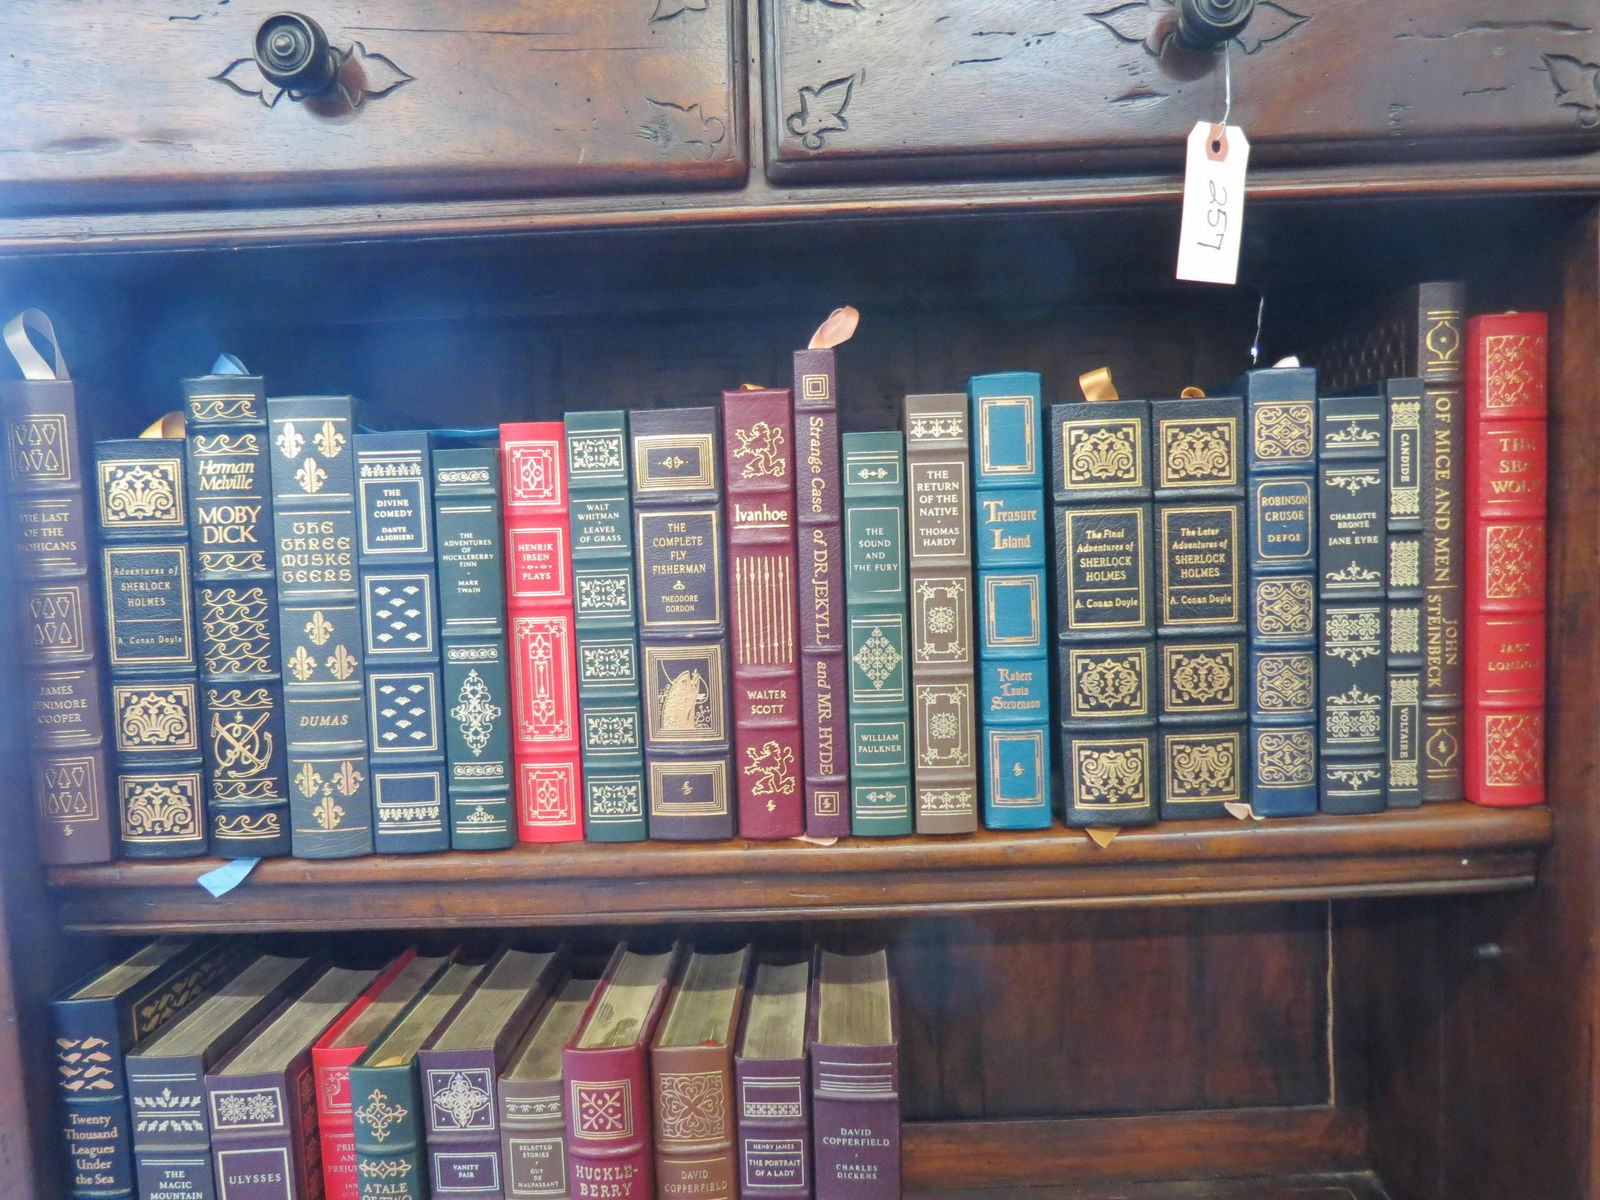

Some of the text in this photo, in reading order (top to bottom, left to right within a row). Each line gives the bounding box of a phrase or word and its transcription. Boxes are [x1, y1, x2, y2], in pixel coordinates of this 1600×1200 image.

[1197, 180, 1228, 250] 257
[808, 416, 824, 474] Strange
[1401, 433, 1410, 483] CANDIDE
[198, 460, 255, 475] Herman
[926, 470, 949, 479] THE
[199, 475, 253, 491] Melville
[916, 481, 960, 492] RETURN
[383, 489, 401, 497] THE
[811, 477, 826, 513] Case
[1434, 397, 1451, 582] OF MICE AND MEN
[376, 499, 409, 508] DIVINE
[919, 494, 958, 504] OF THE
[1261, 495, 1308, 506] ROBINSON
[586, 503, 610, 512] WALT
[734, 503, 788, 522] Ivanhoe
[919, 506, 959, 517] NATIVE
[983, 499, 1037, 524] Treasure
[41, 512, 69, 522] LAST
[198, 505, 262, 525] MOBY
[374, 509, 413, 518] COMEDY
[577, 511, 620, 521] WHITMAN
[1264, 511, 1304, 521] CRUSOE
[1330, 512, 1376, 521] CHARLOTTE
[24, 527, 65, 537] OF THE
[382, 526, 407, 534] DANTE
[584, 525, 616, 534] LEAVES
[667, 523, 687, 533] THE
[865, 527, 884, 536] THE
[919, 527, 959, 536] THOMAS
[1180, 527, 1220, 537] The Later
[203, 525, 258, 544] DICK
[376, 534, 414, 542] ALIGHIERI
[580, 534, 622, 544] OF GRASS
[813, 529, 828, 547] of
[989, 528, 1031, 551] Island
[1086, 529, 1125, 539] The Final
[1267, 533, 1301, 543] DEFOE
[652, 536, 704, 548] COMPLETE
[858, 539, 891, 548] SOUND
[923, 537, 957, 548] HARDY
[1172, 539, 1228, 550] Adventures of
[1328, 535, 1379, 546] JANE EYRE
[517, 543, 554, 552] HENRIK
[1076, 542, 1135, 553] Adventures of
[281, 552, 351, 567] MUSKE
[442, 553, 494, 561] HUCKLEBERRY
[523, 553, 550, 561] IBSEN
[670, 551, 687, 560] FLY
[865, 551, 886, 560] AND
[1174, 553, 1226, 565] SHERLOCK
[854, 563, 899, 572] THE FURY
[1079, 556, 1132, 568] SHERLOCK
[113, 565, 178, 576] Adventures of
[652, 563, 706, 575] FISHERMAN
[1180, 567, 1220, 579] HOLMES
[522, 572, 552, 580] PLAYS
[1086, 570, 1126, 582] HOLMES
[121, 581, 170, 590] SHERLOCK
[128, 597, 166, 607] HOLMES
[661, 595, 699, 603] THEODORE
[1075, 597, 1138, 609] A. Conan Doyle
[1170, 594, 1231, 605] A. Conan Doyle
[665, 604, 695, 613] GORDON
[811, 577, 830, 646] JEKYLL
[130, 636, 154, 644] Conan
[158, 635, 182, 645] Doyle
[1427, 594, 1442, 688] STEINBECK
[1442, 617, 1457, 665] JOHN
[817, 661, 831, 689] and
[997, 667, 1033, 682] Robert
[40, 685, 74, 695] JAMES
[746, 689, 788, 700] WALTER
[751, 703, 785, 714] SCOTT
[38, 713, 82, 723] COOPER
[299, 714, 349, 728] DUMAS
[861, 734, 899, 743] WILLIAM
[1400, 707, 1409, 759] VOLTAIRE
[819, 726, 834, 776] HYDE
[858, 744, 902, 753] FAULKNER
[69, 1114, 112, 1127] Twenty
[64, 1127, 119, 1140] Thousand
[840, 1128, 872, 1136] DAVID
[822, 1136, 891, 1147] COPPERFIELD
[71, 1143, 115, 1158] Leagues
[76, 1158, 112, 1169] Under
[764, 1159, 801, 1167] PORTRAIT
[836, 1163, 878, 1172] CHARLES
[164, 1170, 185, 1179] THE
[458, 1171, 475, 1179] FAIR
[575, 1165, 640, 1180] HUCKLE-
[681, 1169, 709, 1181] DAVID
[755, 1169, 795, 1177] OF A LADY
[837, 1172, 878, 1180] DICKENS
[76, 1173, 115, 1185] the Sea
[229, 1173, 282, 1185] ULYSSES
[159, 1181, 193, 1190] MAGIC
[364, 1182, 408, 1194] A TALE
[580, 1182, 633, 1197] BERRY
[664, 1181, 729, 1194] COPPERFIELD
[150, 1192, 203, 1200] MOUNTAIN
